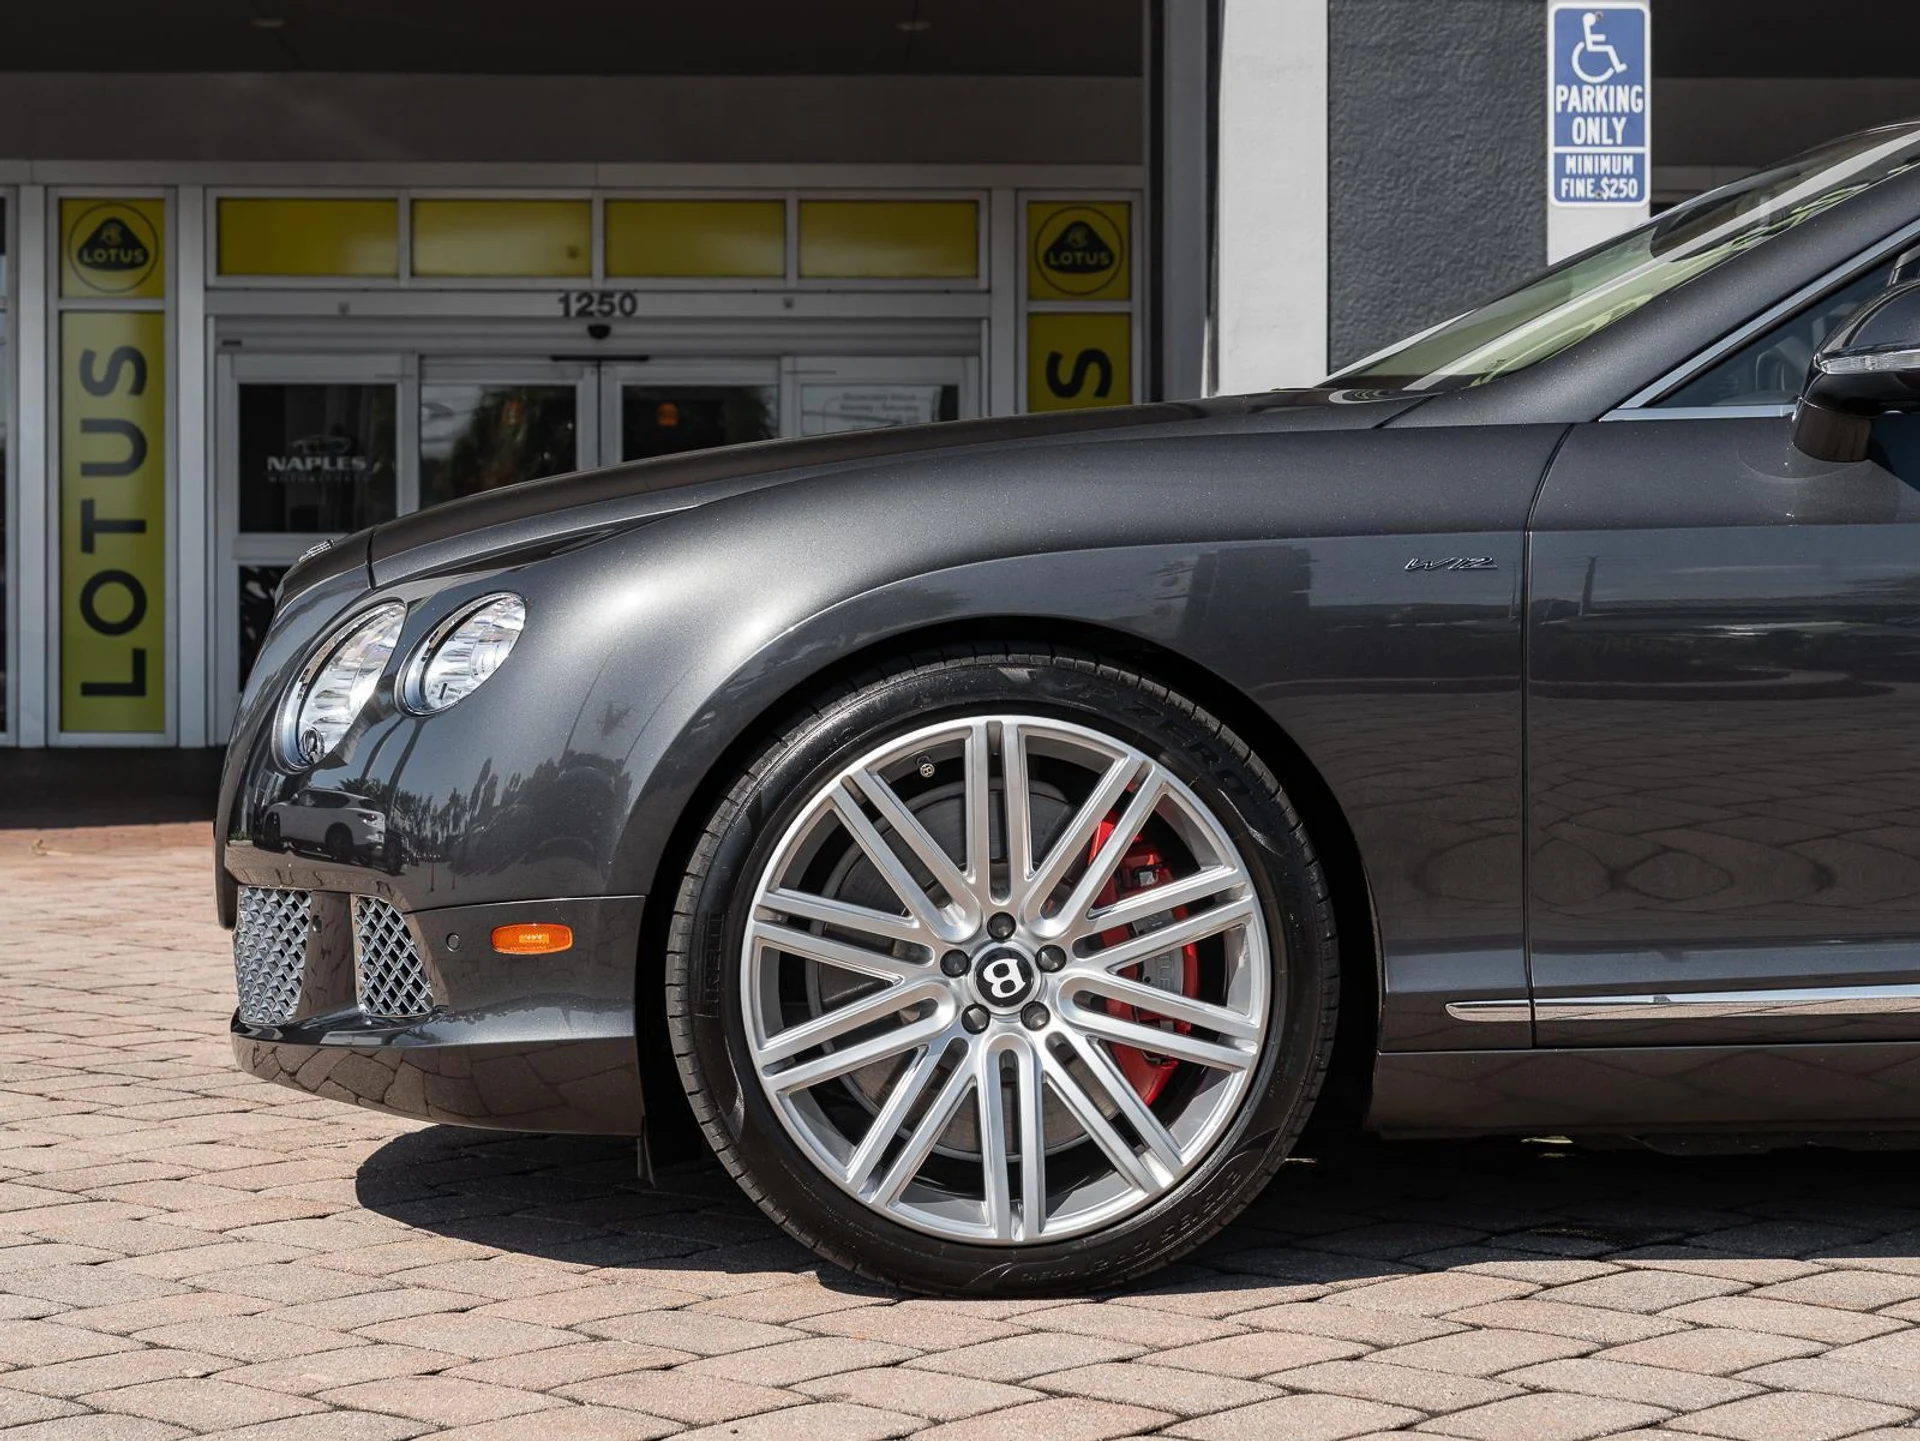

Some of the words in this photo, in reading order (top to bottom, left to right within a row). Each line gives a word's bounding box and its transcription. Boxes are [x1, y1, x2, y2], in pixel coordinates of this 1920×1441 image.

[1555, 85, 1644, 113] PARKING
[1571, 116, 1628, 145] ONLY
[1565, 155, 1634, 175] MINIMUM
[1560, 178, 1595, 198] FINE
[1600, 177, 1638, 200] $250
[82, 248, 145, 264] LOTUS
[1049, 251, 1110, 266] LOTUS
[556, 290, 638, 318] 1250
[266, 455, 367, 471] NAPLES
[79, 345, 148, 697] LOTUS
